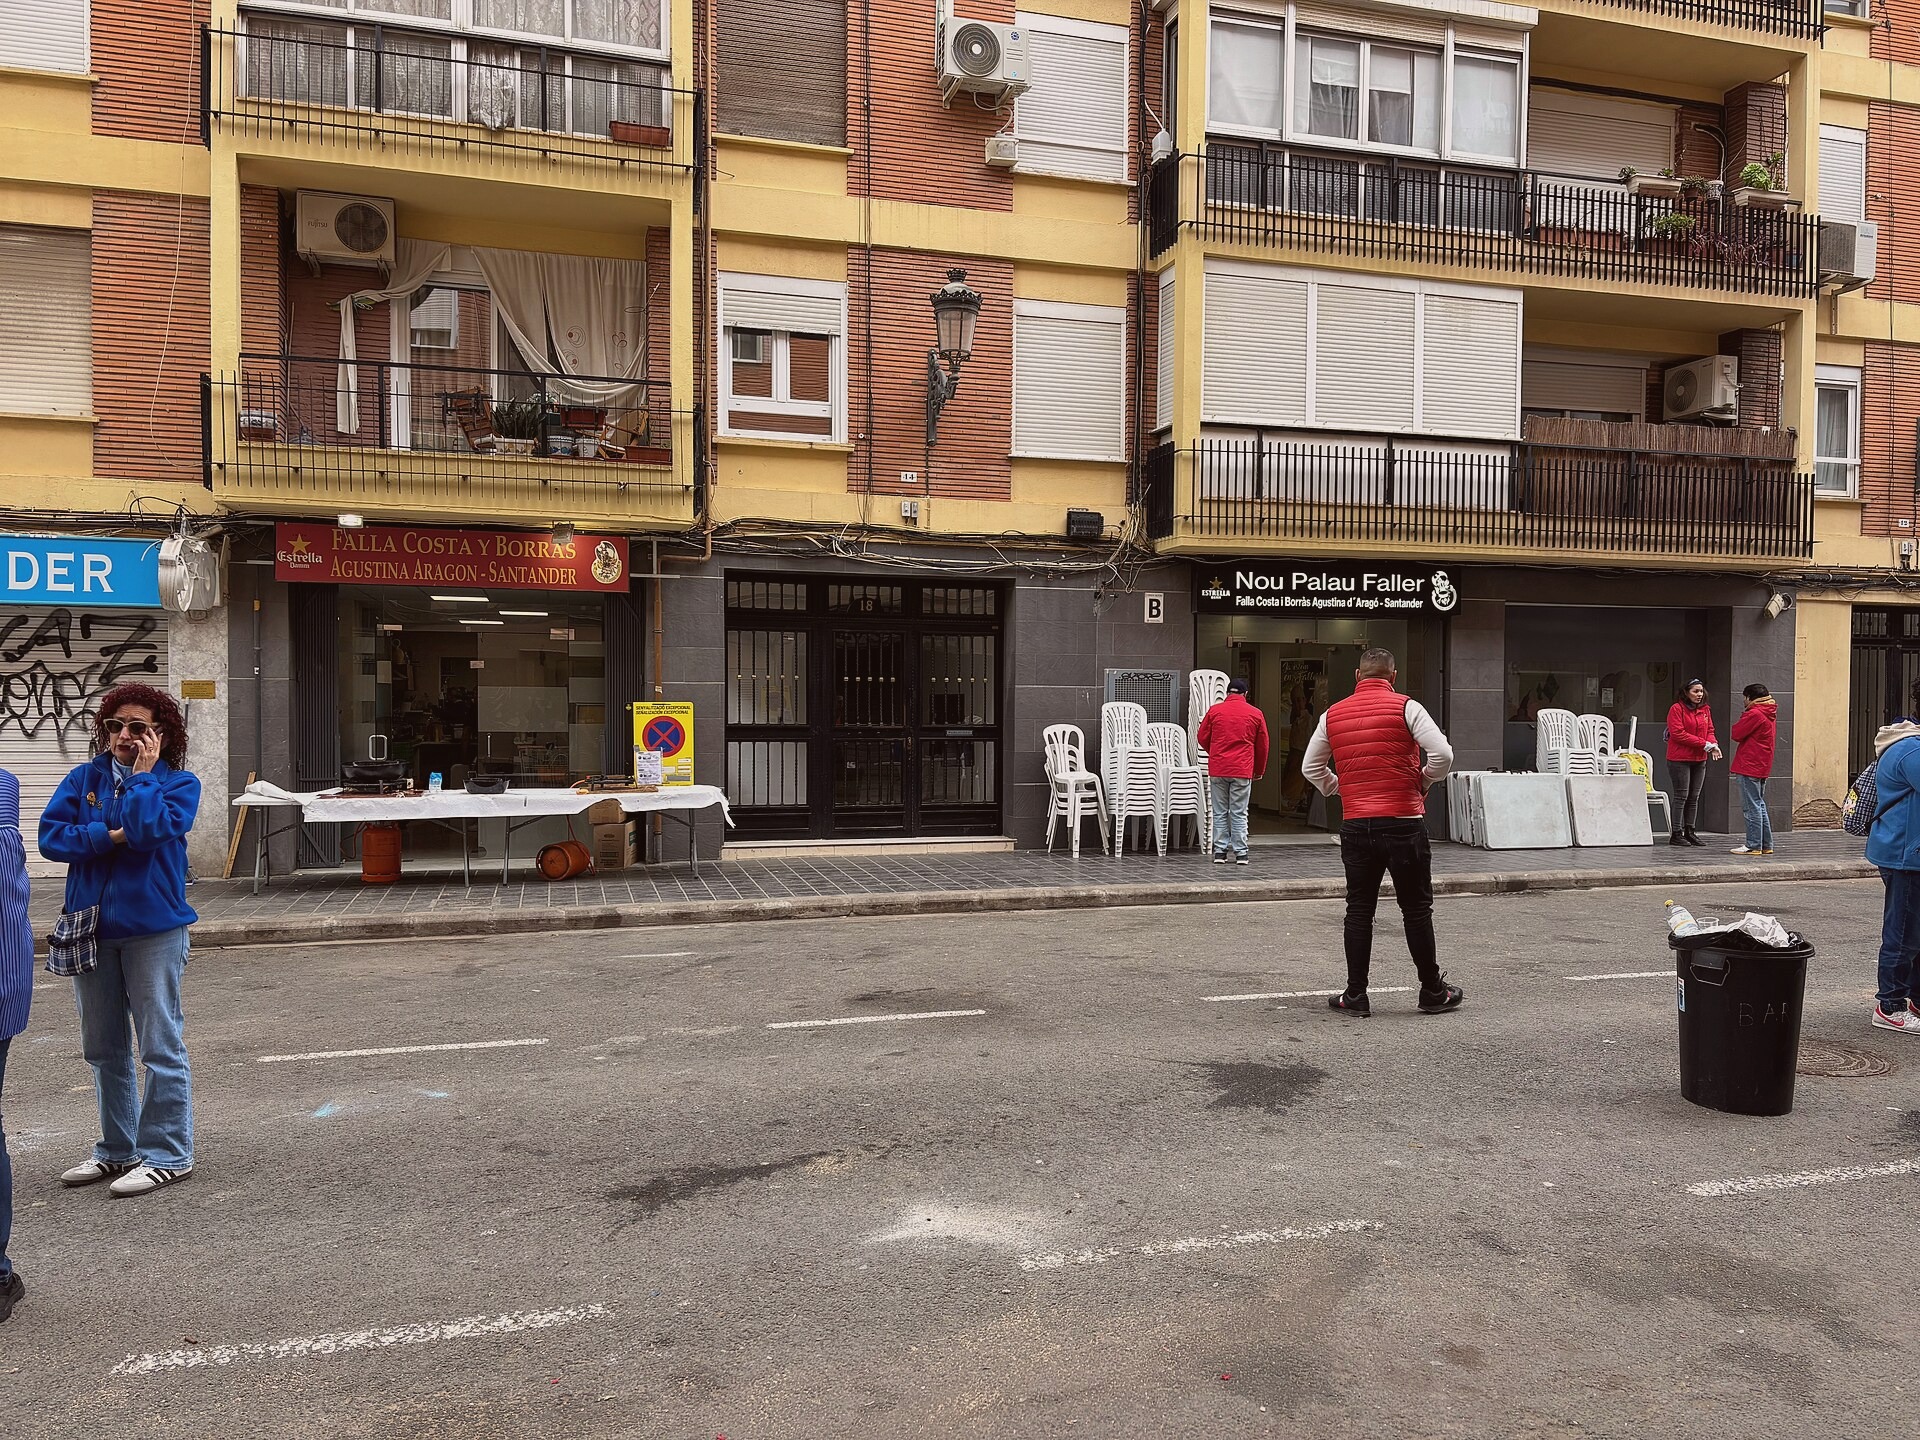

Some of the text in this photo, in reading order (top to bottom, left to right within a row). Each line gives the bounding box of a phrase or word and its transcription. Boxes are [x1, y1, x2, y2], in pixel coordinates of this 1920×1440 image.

[332, 528, 577, 559] FALLA COSTA Y BORRAS
[277, 549, 323, 563] Estrella
[7, 551, 114, 593] DER
[330, 555, 410, 579] AGUSTINA
[413, 558, 478, 582] ARAGON
[489, 561, 577, 585] SANTANDER
[1235, 571, 1425, 592] Nou Palau Faller
[1201, 589, 1231, 597] ESTRELLA
[1235, 595, 1255, 607] Falla
[1256, 596, 1280, 607] Costa
[1281, 596, 1284, 607] i
[1285, 596, 1311, 607] Borràs
[1312, 597, 1345, 609] Agustina
[1385, 598, 1424, 609] Santander
[860, 600, 873, 611] 18
[1149, 599, 1161, 618] B
